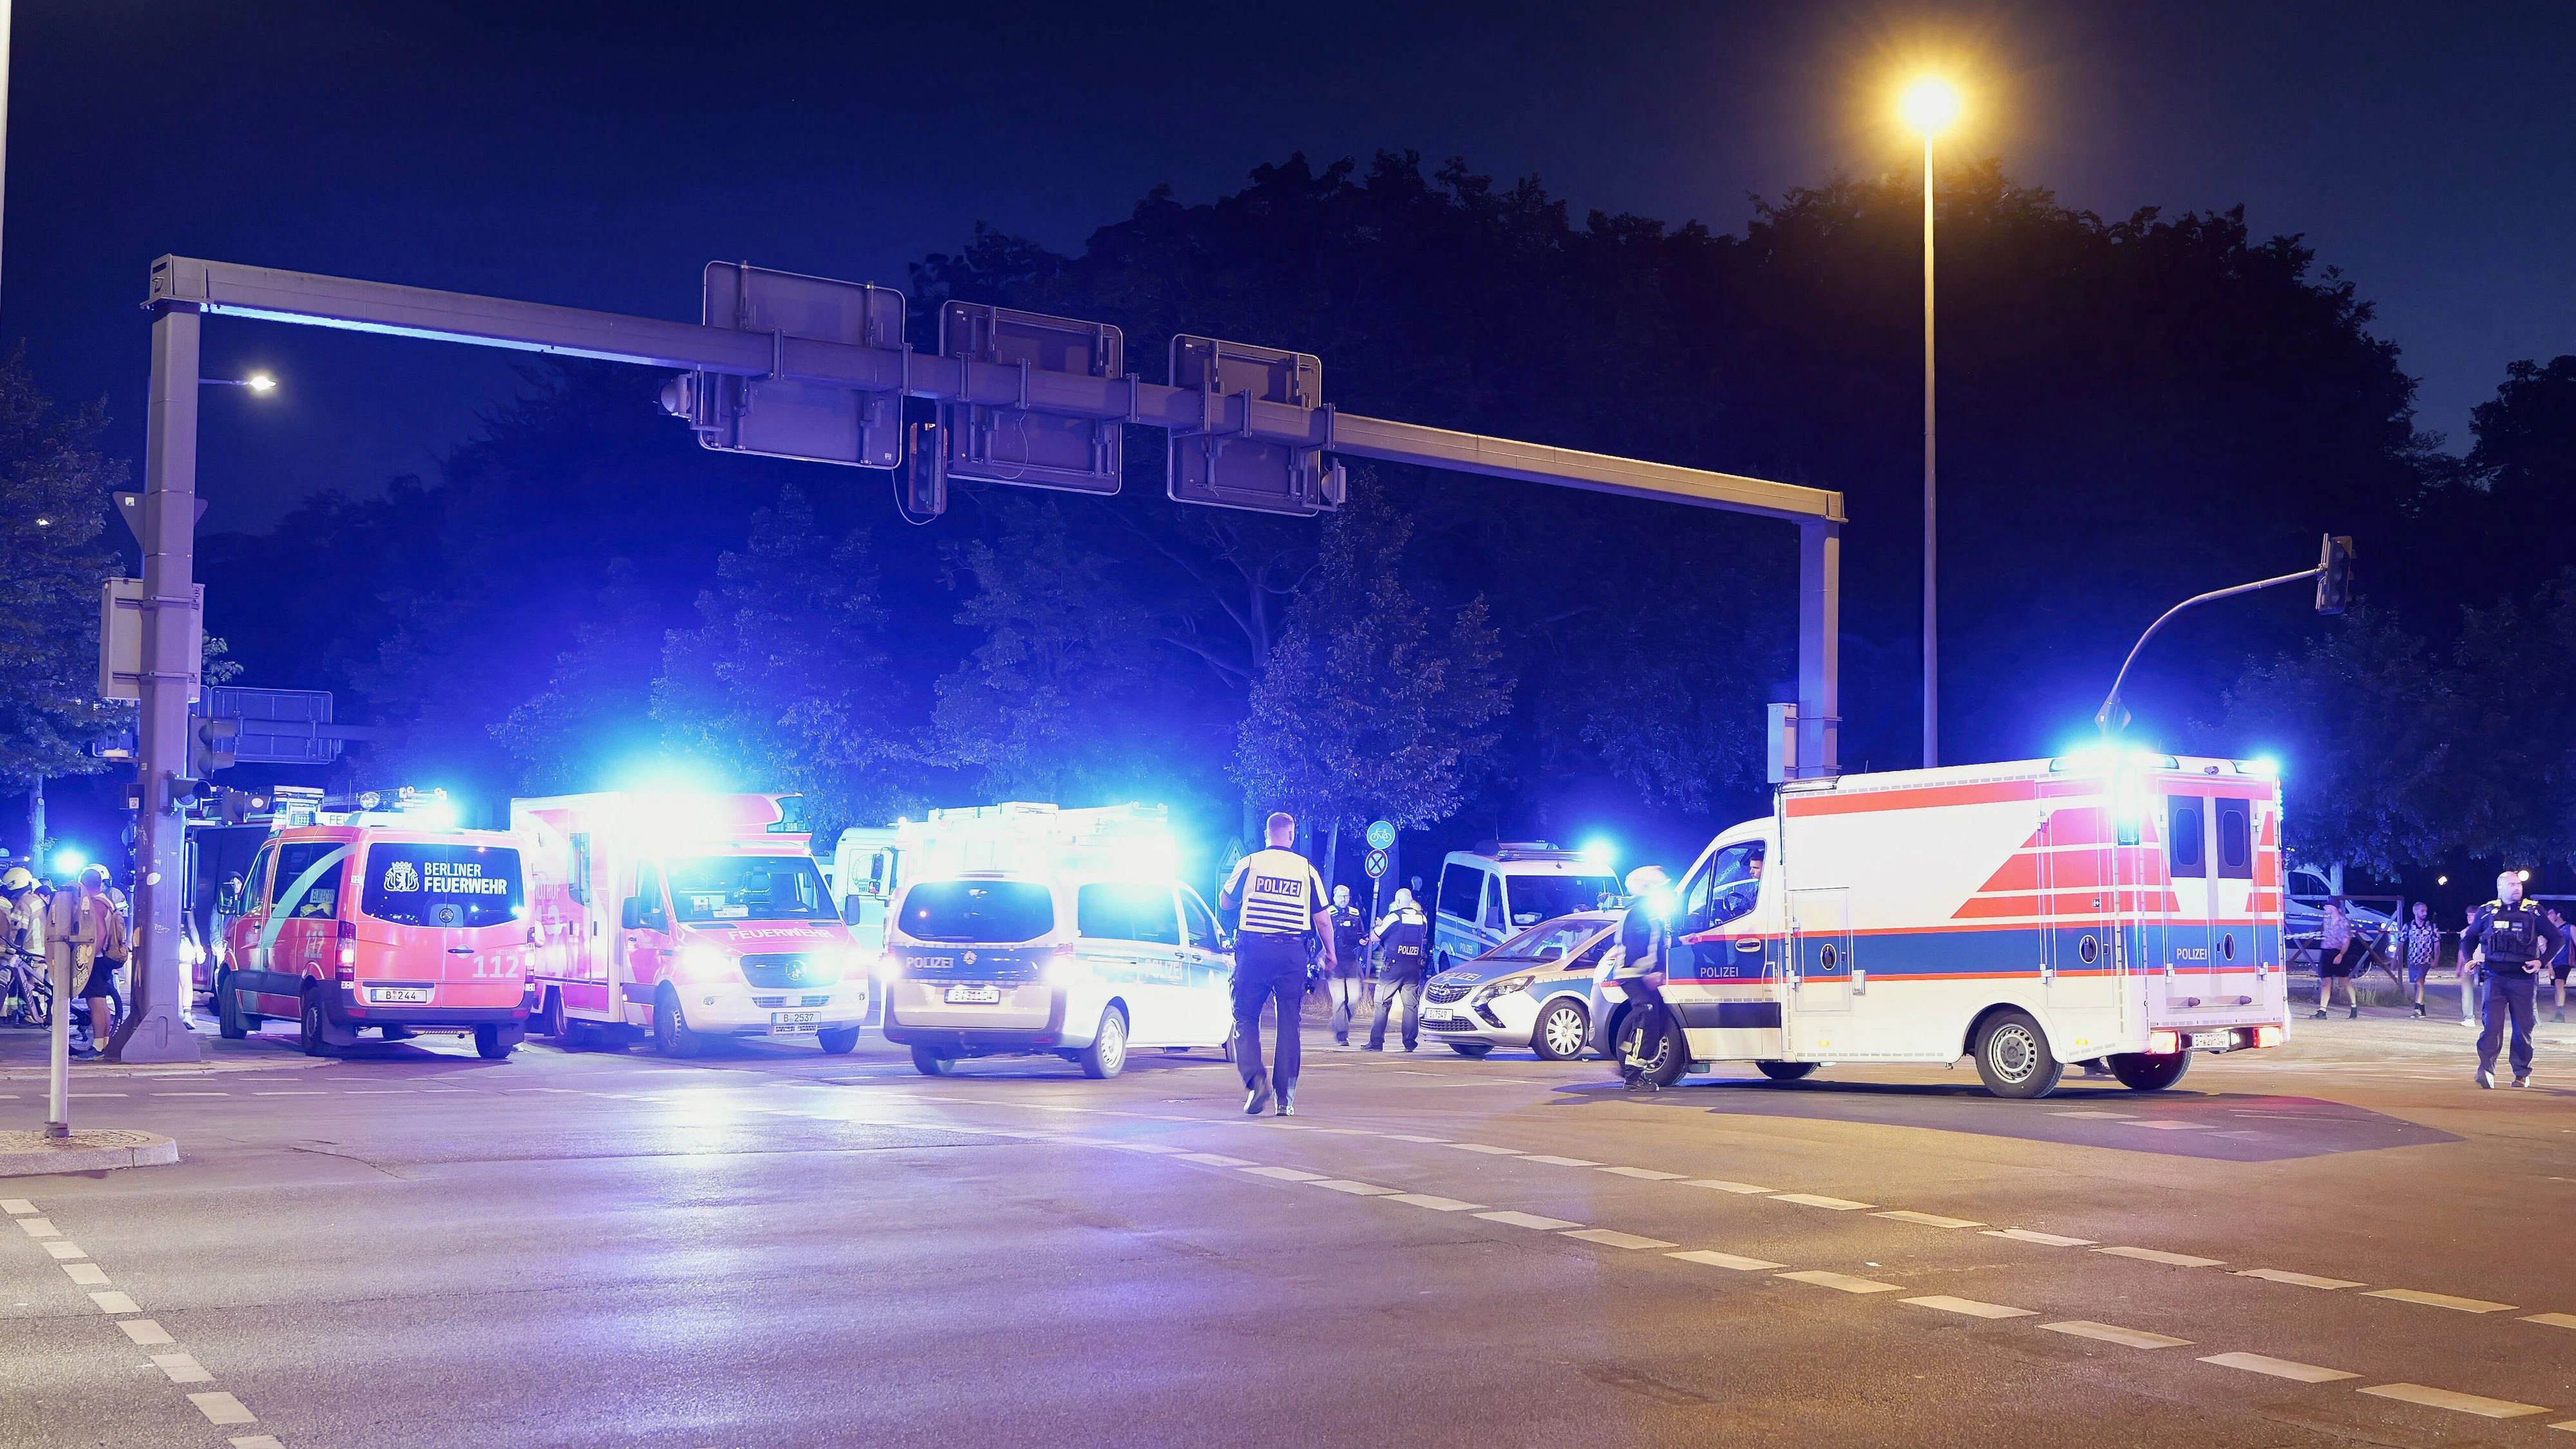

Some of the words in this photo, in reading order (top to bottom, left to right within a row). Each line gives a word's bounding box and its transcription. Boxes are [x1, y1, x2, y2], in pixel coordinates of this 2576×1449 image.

[424, 862, 482, 877] BERLINER
[424, 876, 507, 895] FEUERWEHR
[1256, 877, 1302, 896] POLIZEI
[727, 927, 835, 942] FEUERWEHR
[304, 930, 325, 958] 112
[1397, 945, 1419, 956] POLIZEI
[1459, 942, 1473, 955] POLIZEI
[2177, 948, 2208, 960] POLIZEI
[472, 955, 519, 978] 112
[906, 956, 954, 969] POLIZEI
[1441, 972, 1482, 982] POLIZEI
[1700, 967, 1739, 978] POLIZEI
[386, 991, 392, 1000] B
[398, 991, 416, 1000] 244
[784, 1014, 790, 1023] B
[794, 1013, 815, 1023] 2537
